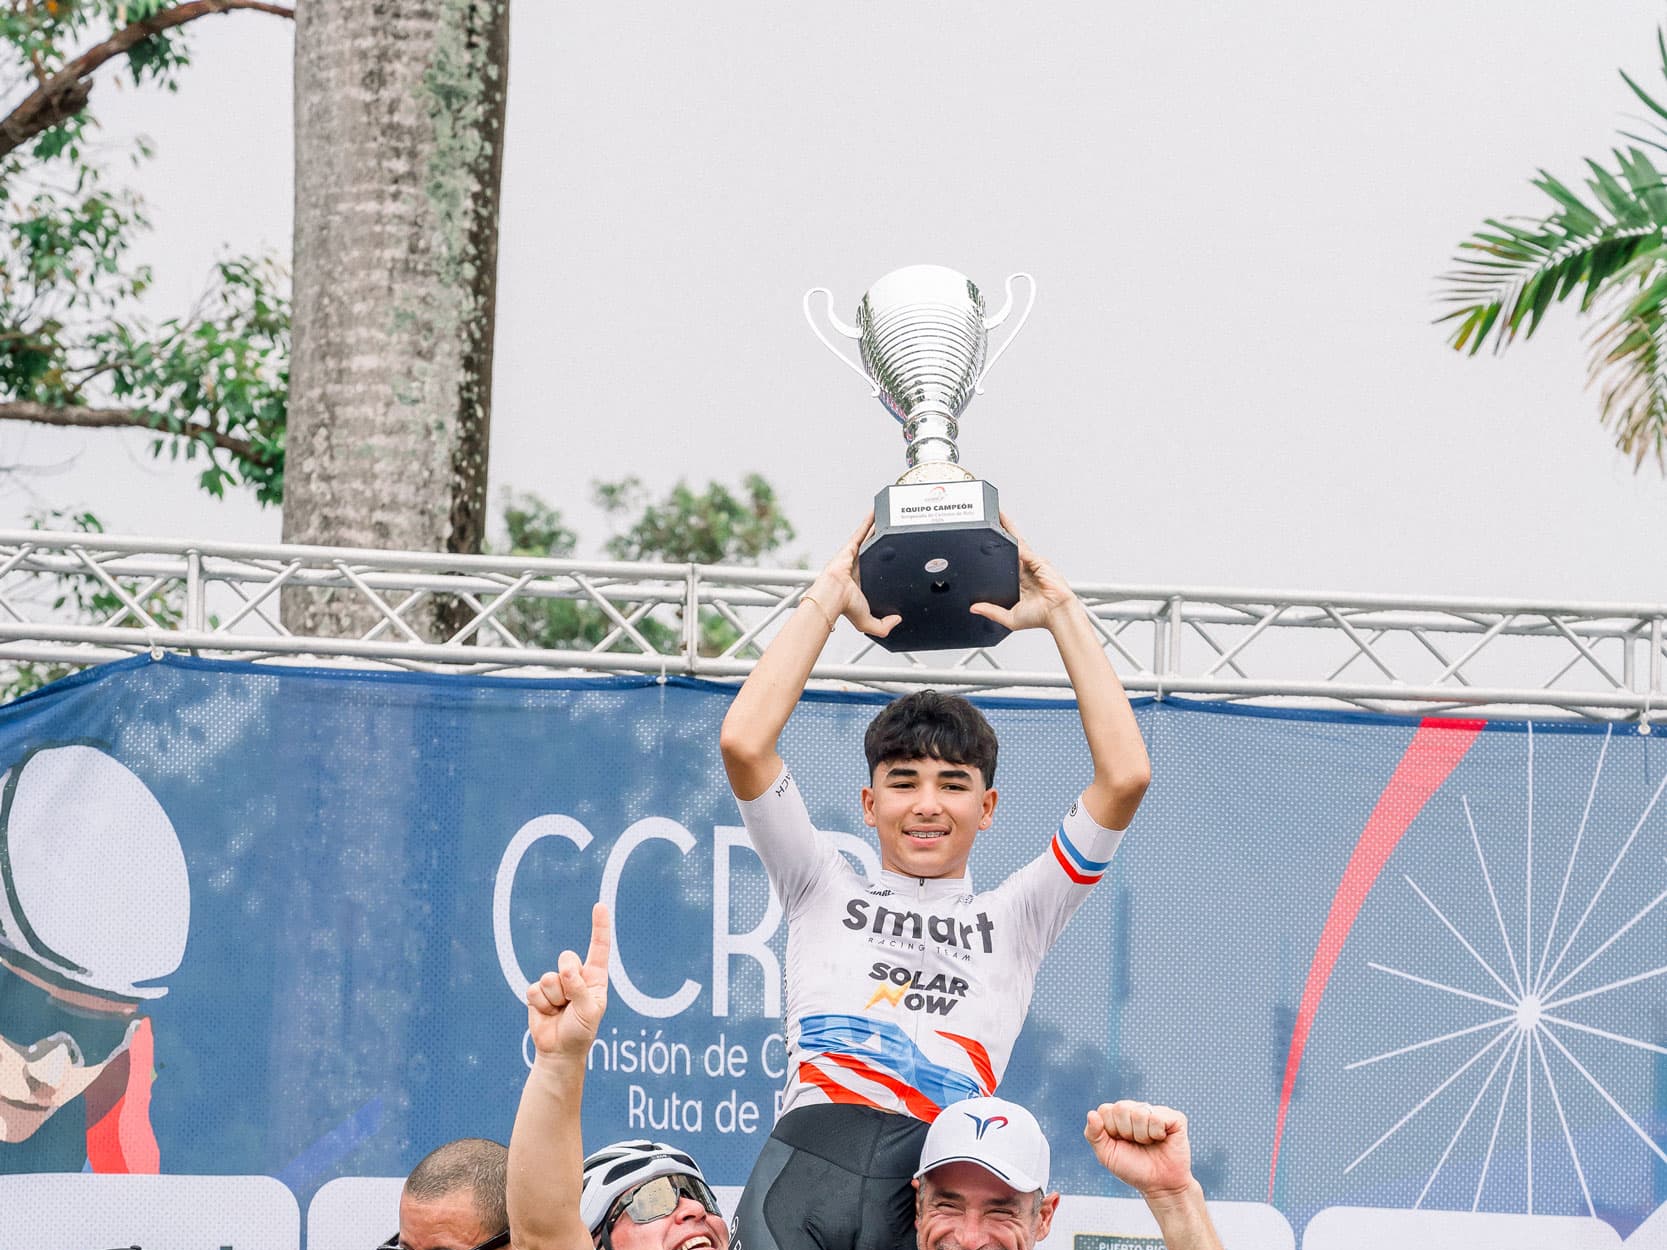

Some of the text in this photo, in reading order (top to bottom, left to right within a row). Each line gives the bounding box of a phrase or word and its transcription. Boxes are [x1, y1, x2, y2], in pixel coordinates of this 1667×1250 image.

[842, 899, 994, 953] smart
[868, 937, 971, 961] RACING TEAM
[868, 962, 969, 998] SOLAR
[703, 1033, 748, 1078] de
[628, 1084, 703, 1133] Ruta
[714, 1089, 760, 1134] de
